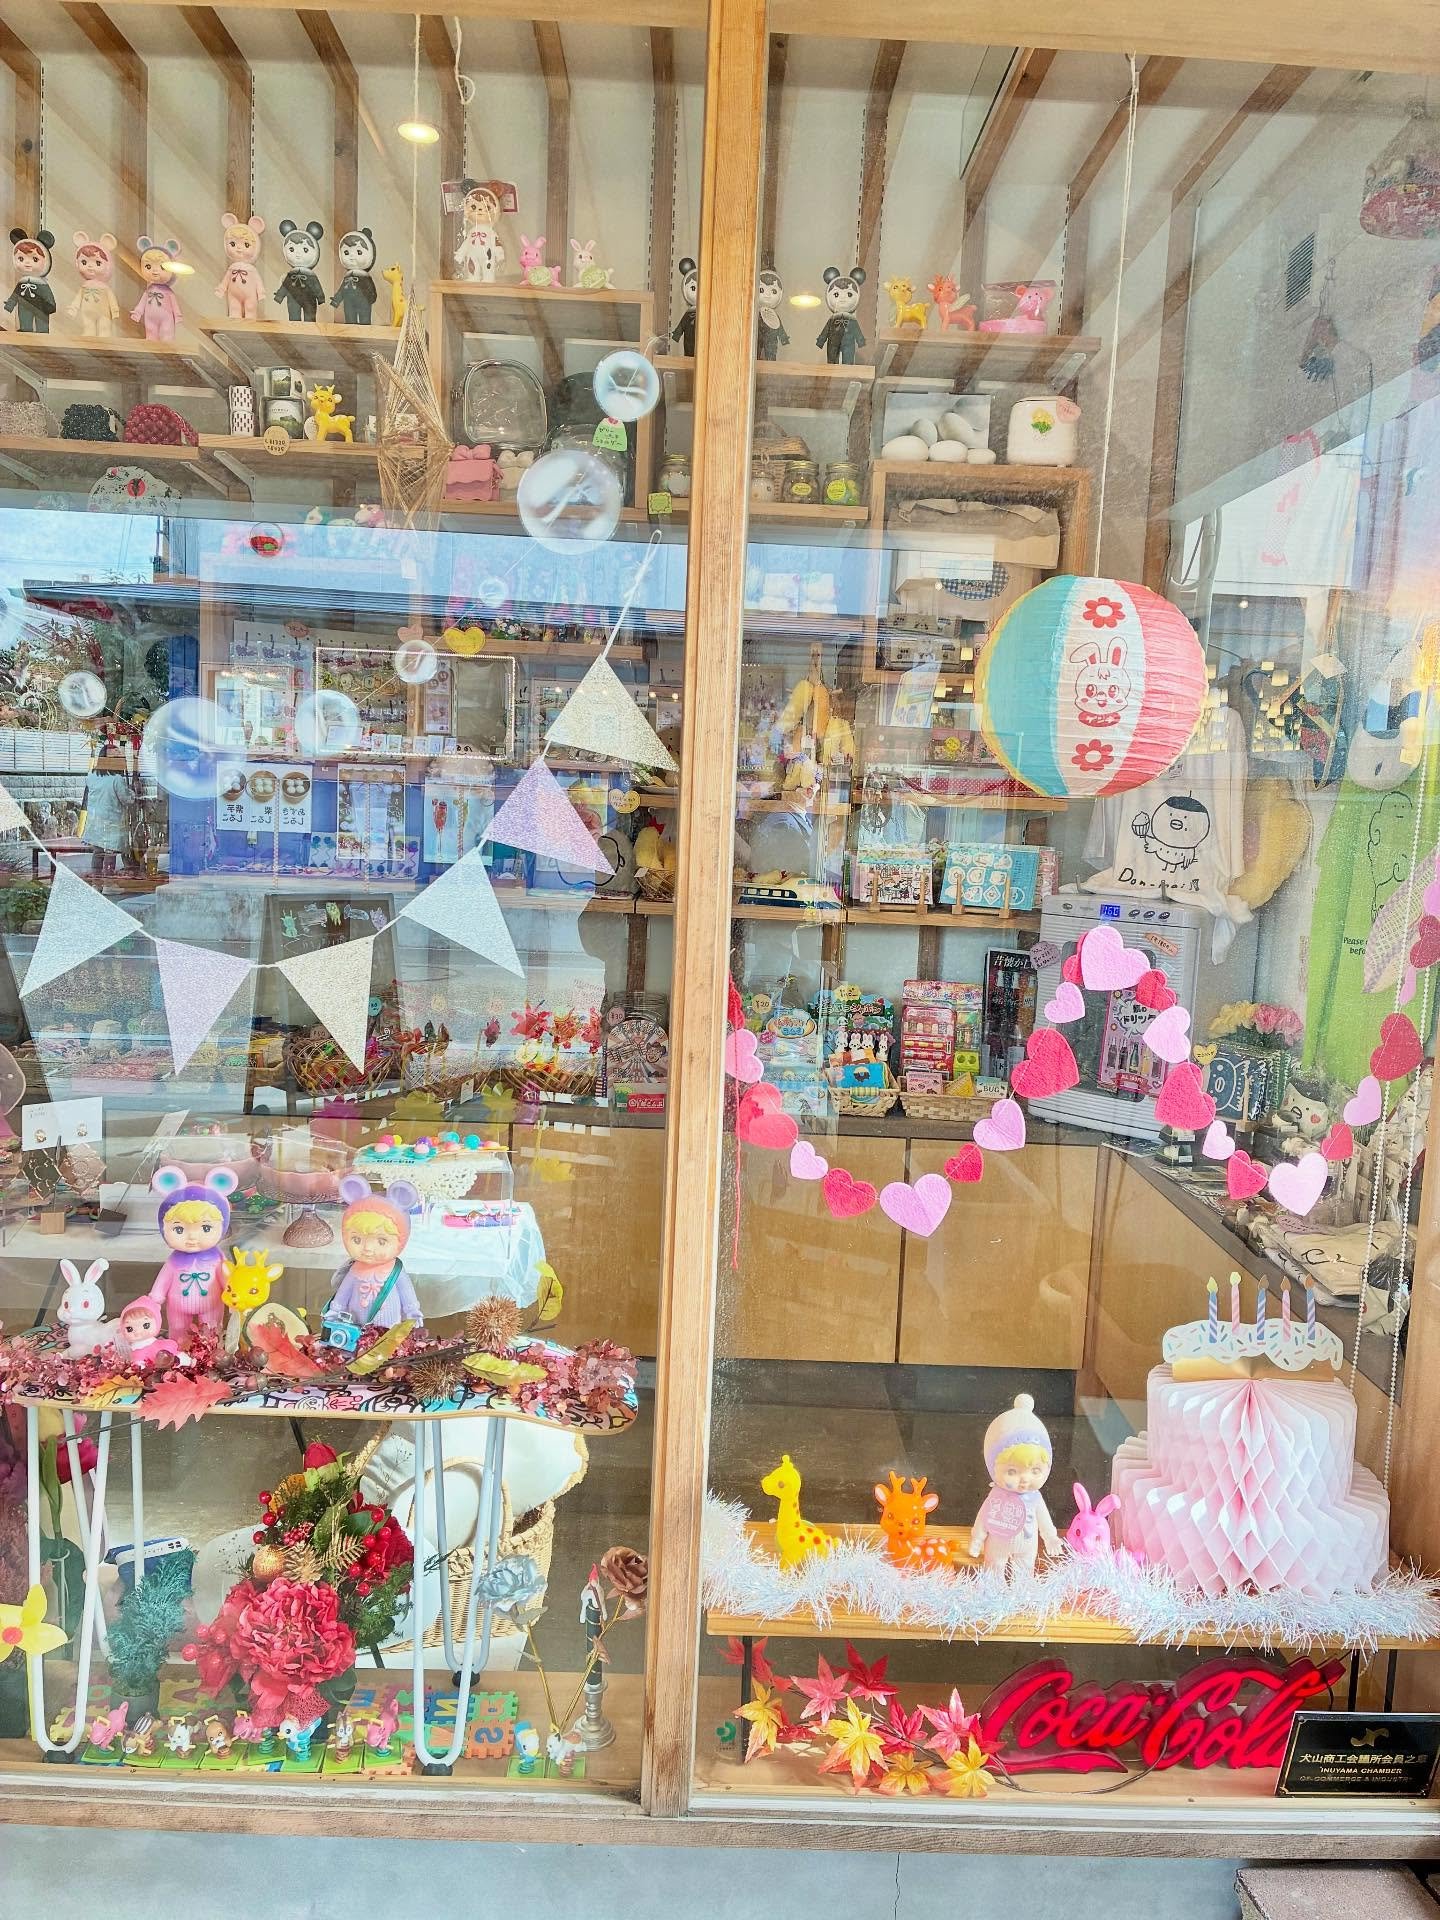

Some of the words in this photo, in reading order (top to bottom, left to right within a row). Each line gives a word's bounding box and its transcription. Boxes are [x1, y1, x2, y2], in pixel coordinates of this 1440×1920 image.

[1343, 936, 1365, 945] Please
[1349, 947, 1366, 956] befo
[993, 954, 1034, 970] 昔懐かし
[983, 1085, 1000, 1093] BUG
[1319, 1767, 1358, 1775] INUYAMA
[1360, 1767, 1403, 1775] CHAMBER
